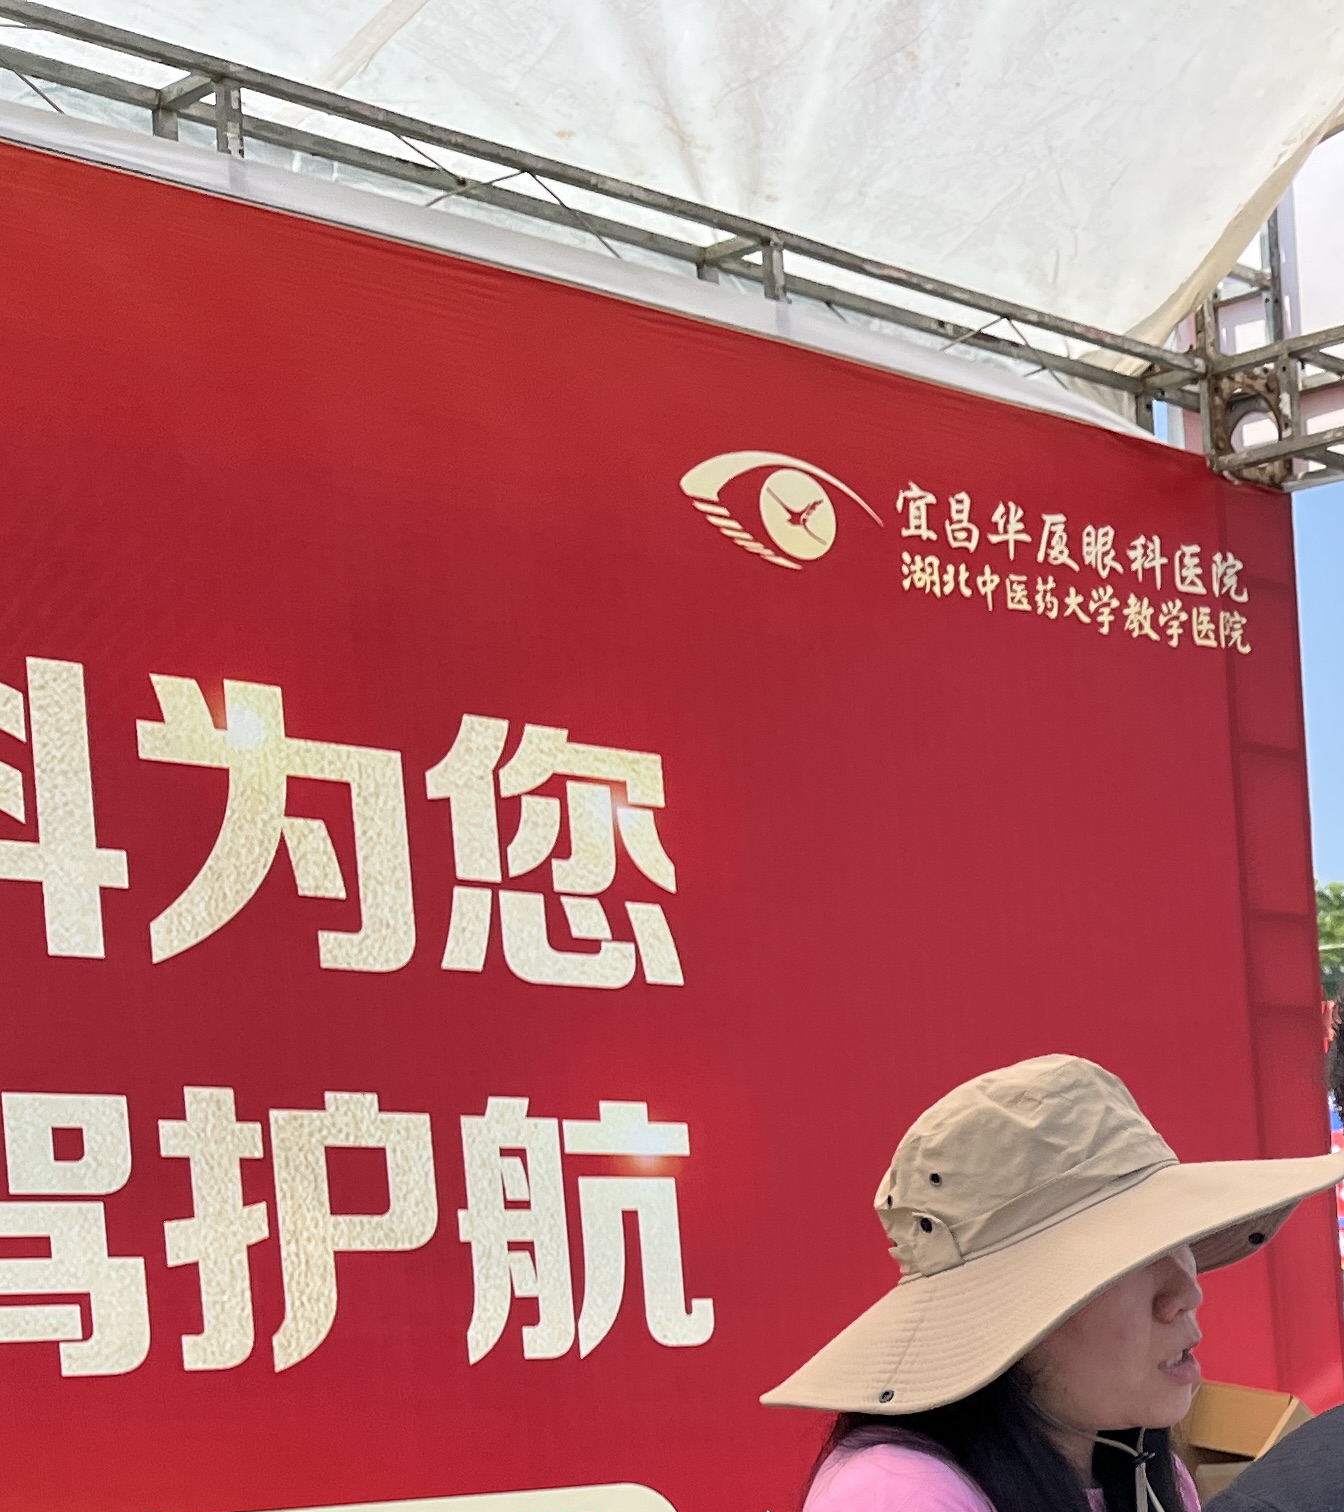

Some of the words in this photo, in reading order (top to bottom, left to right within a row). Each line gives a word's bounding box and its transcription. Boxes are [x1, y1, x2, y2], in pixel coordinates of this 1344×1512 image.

[896, 481, 1249, 602] 宜昌华厦眼科医院
[901, 551, 1251, 654] 湖北中医药大学教学医院
